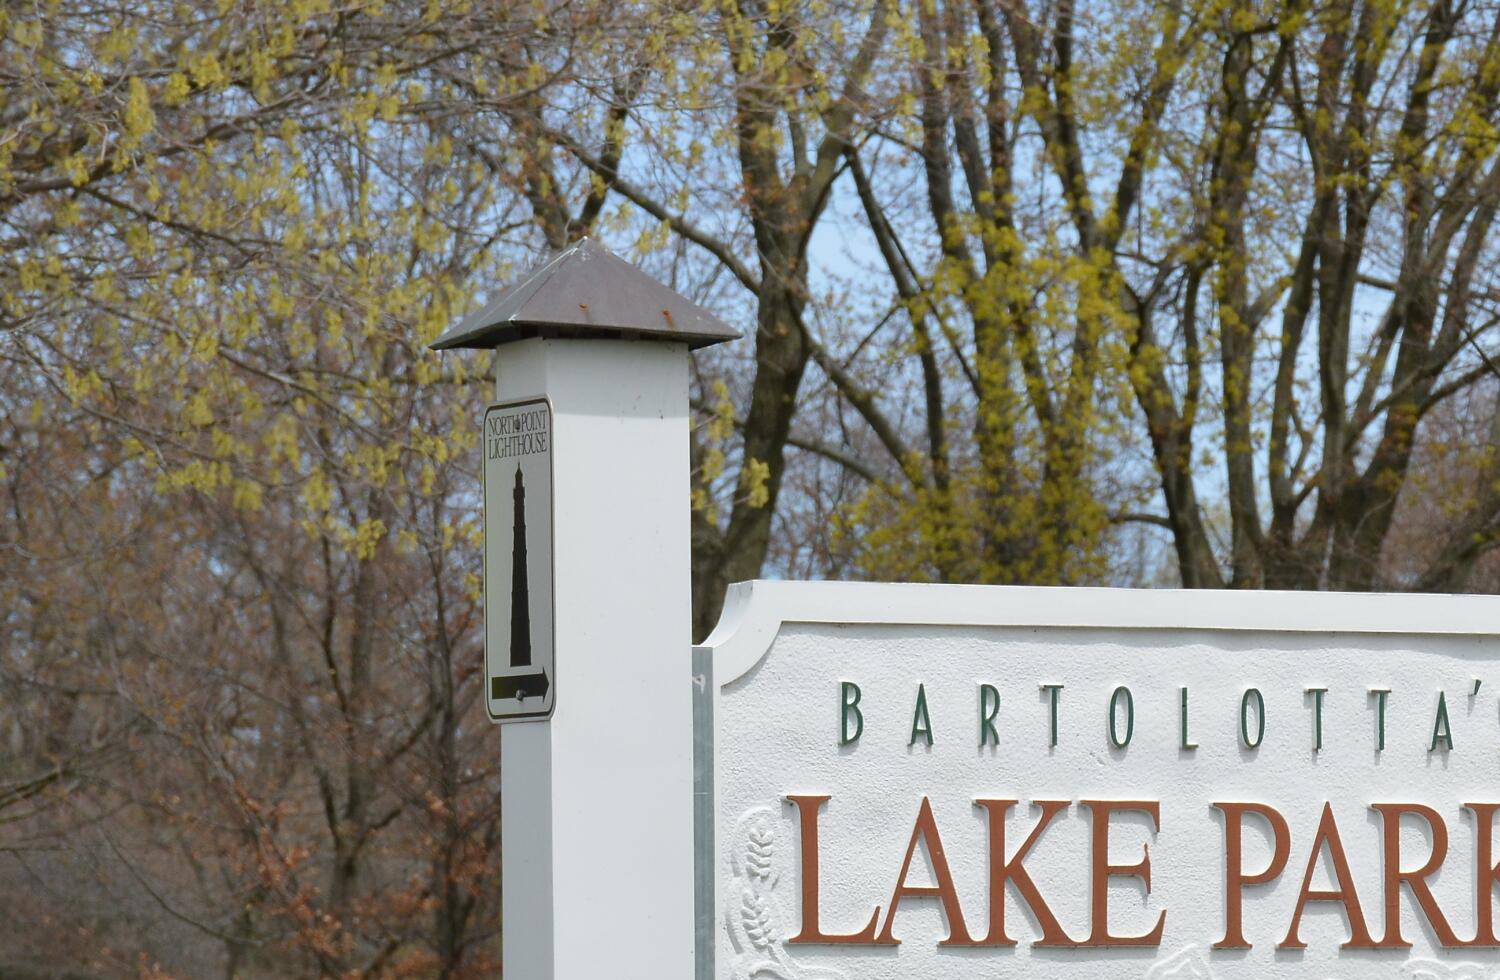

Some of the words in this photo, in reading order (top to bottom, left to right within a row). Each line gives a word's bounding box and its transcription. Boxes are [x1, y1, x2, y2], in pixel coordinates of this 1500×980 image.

[488, 414, 520, 436] NORTH
[521, 410, 547, 432] POINT
[488, 432, 547, 460] LIGHTHOUSE
[785, 795, 1167, 948] LAKE
